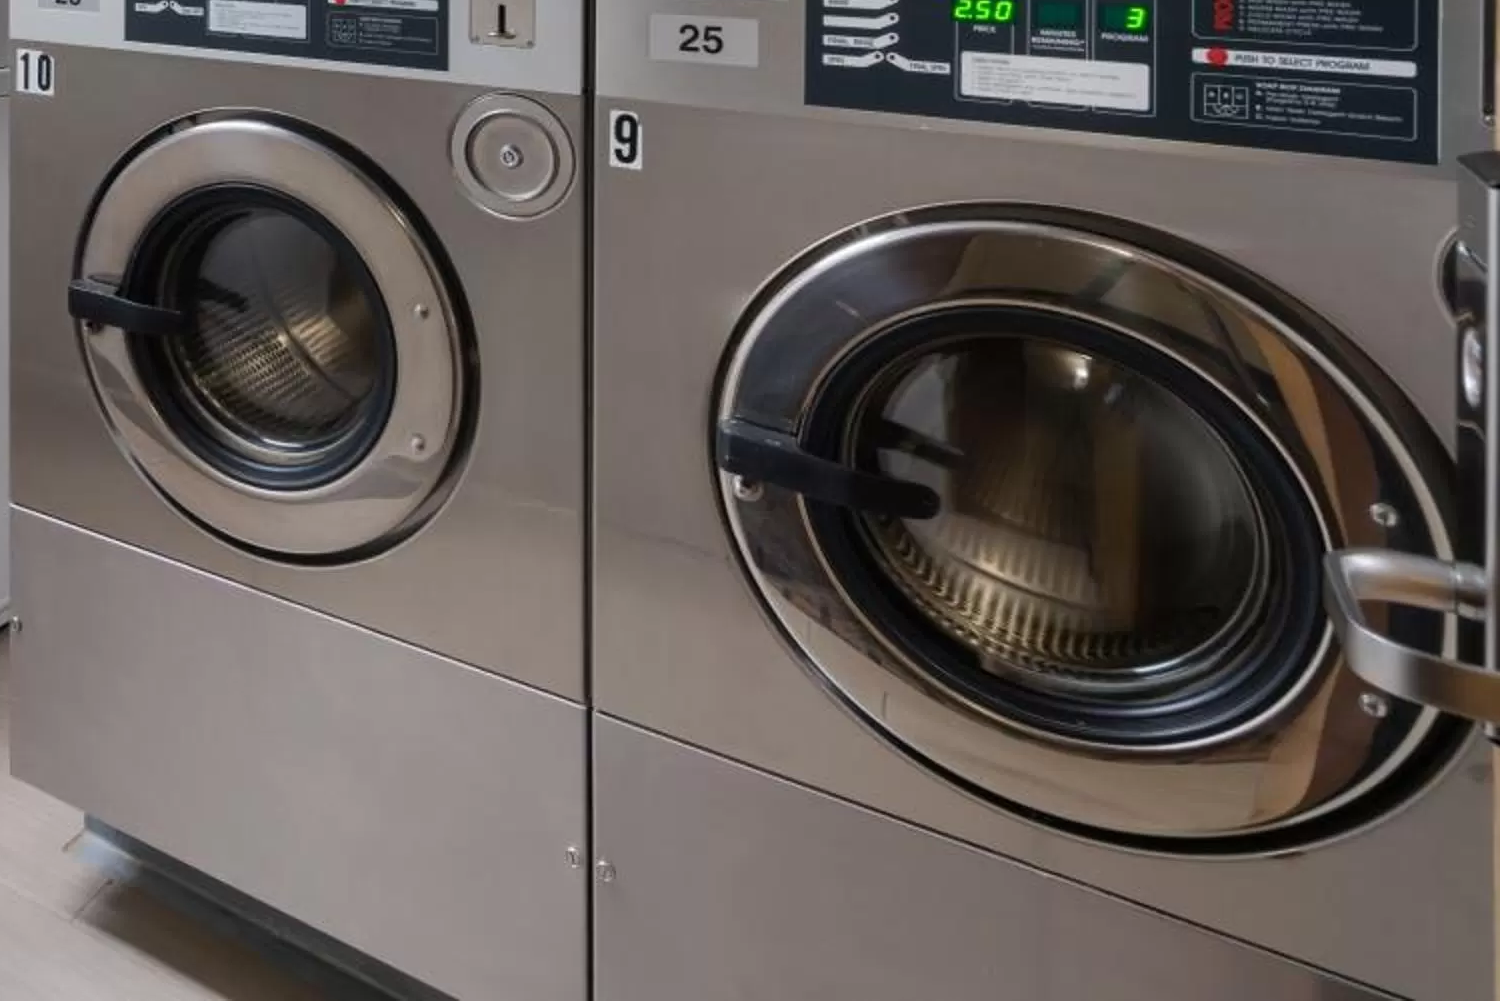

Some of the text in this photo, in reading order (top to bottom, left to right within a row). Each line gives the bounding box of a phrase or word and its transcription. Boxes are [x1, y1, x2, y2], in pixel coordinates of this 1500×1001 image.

[955, 0, 1012, 21] 2.50
[1126, 8, 1145, 29] 3
[678, 24, 724, 54] 25
[20, 52, 51, 91] 10
[614, 113, 638, 164] 9
